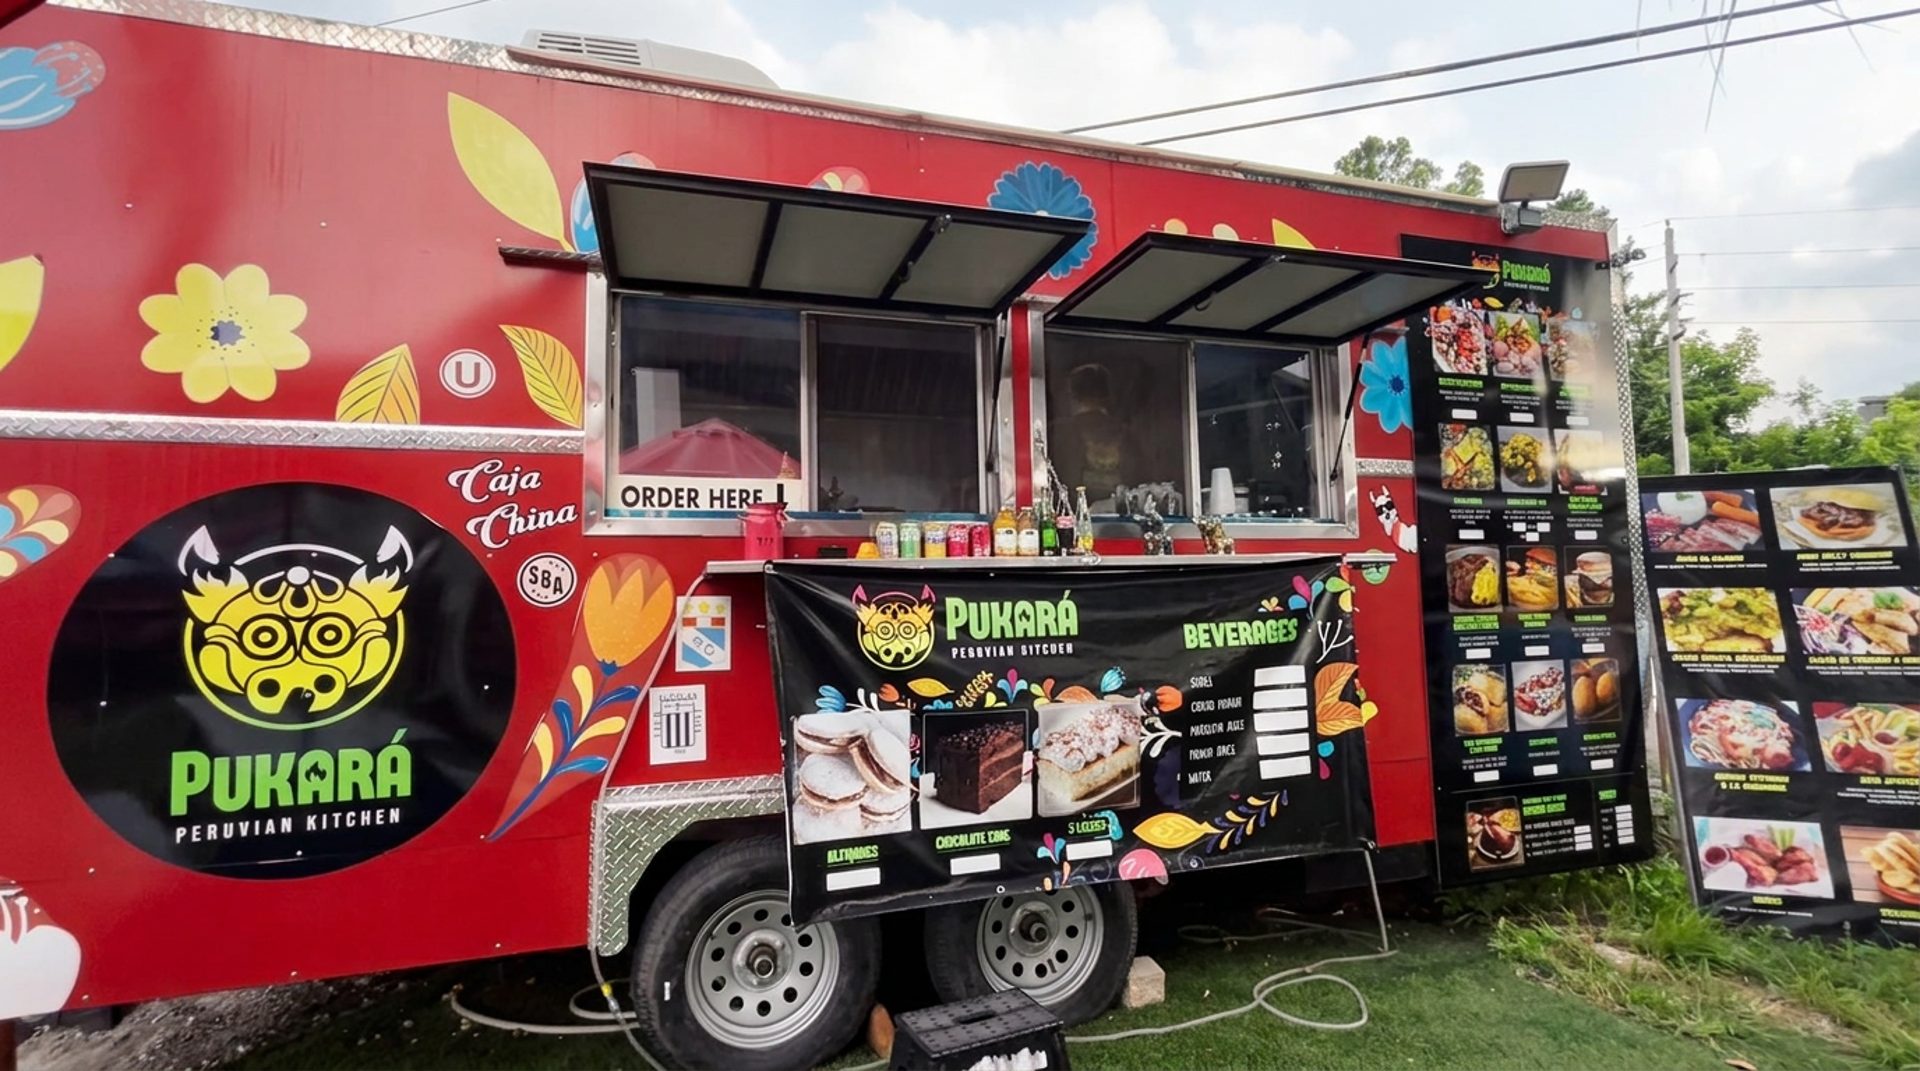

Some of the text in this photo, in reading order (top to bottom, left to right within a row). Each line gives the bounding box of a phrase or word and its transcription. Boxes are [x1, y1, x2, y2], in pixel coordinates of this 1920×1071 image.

[455, 361, 481, 388] U
[448, 460, 541, 503] Caja
[621, 485, 763, 508] ORDER HERE
[466, 503, 577, 549] China
[528, 565, 563, 595] SBA
[945, 589, 1079, 641] PUKARÁ
[1183, 618, 1298, 649] BEVERAGES
[170, 728, 413, 817] PUKARÁ
[176, 807, 400, 844] PERUVIAN KITCHEN
